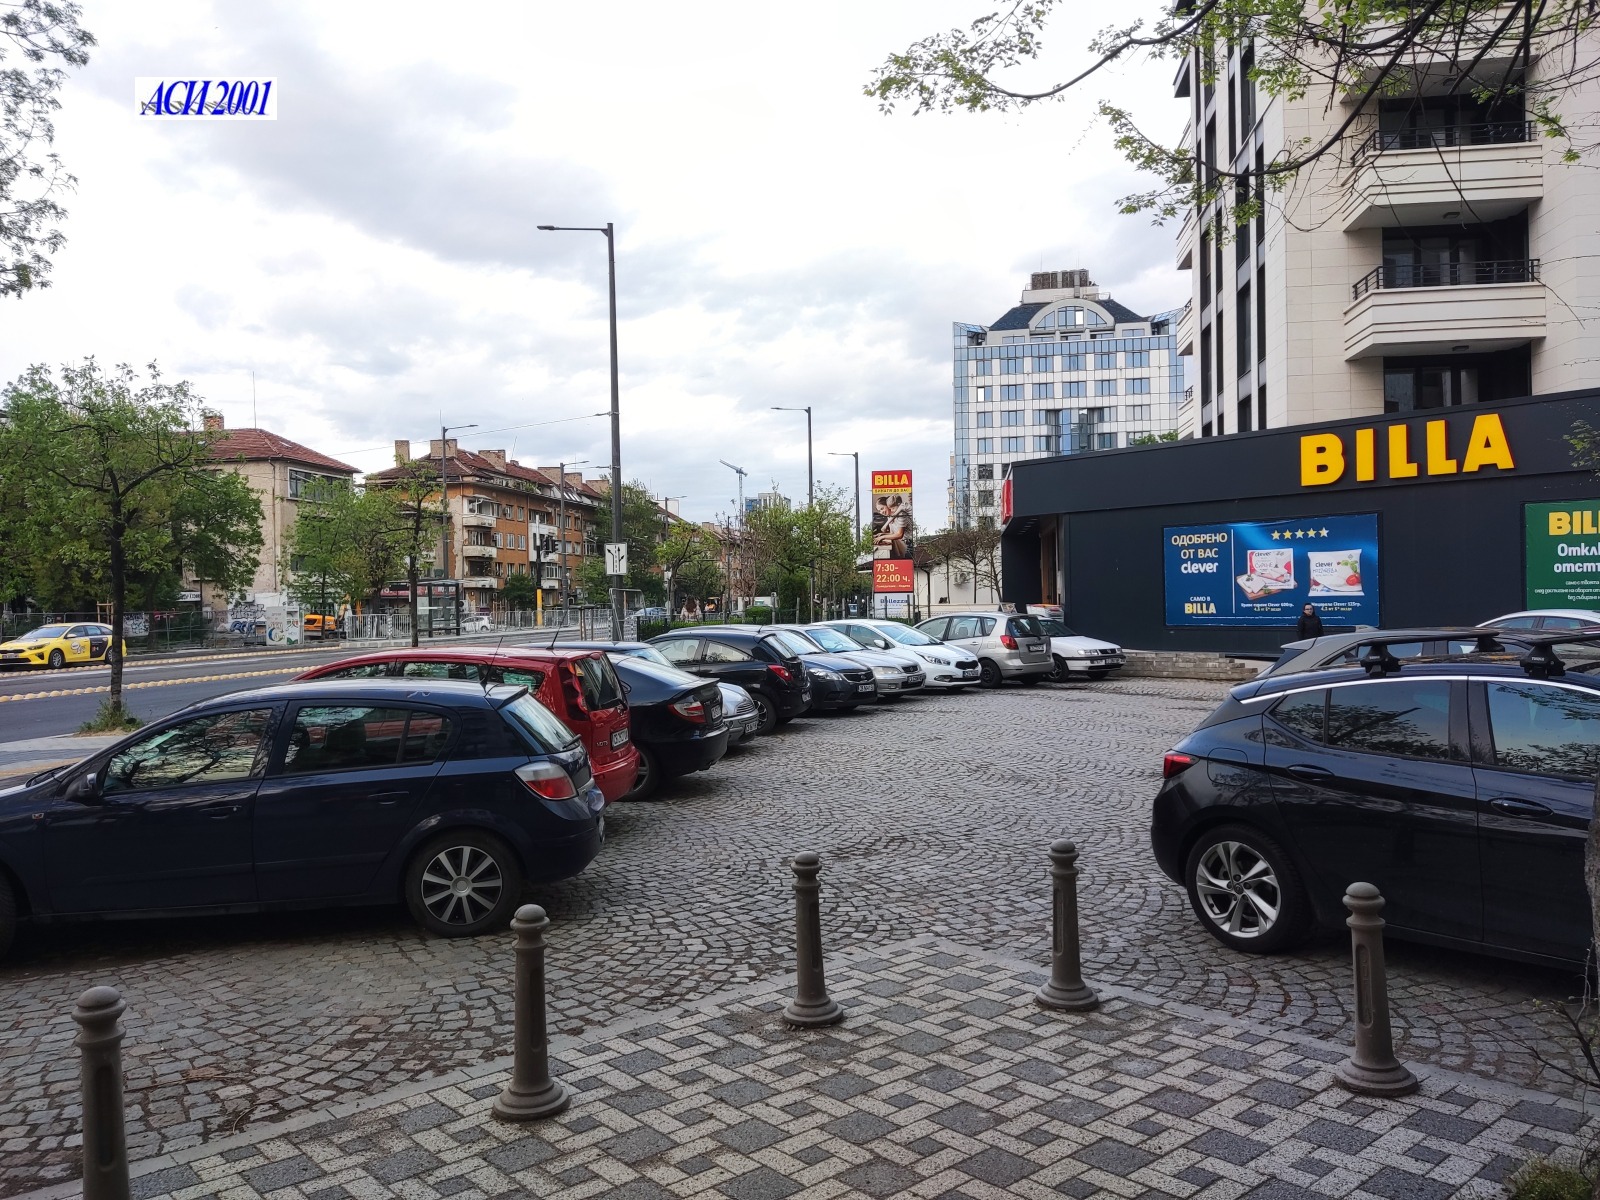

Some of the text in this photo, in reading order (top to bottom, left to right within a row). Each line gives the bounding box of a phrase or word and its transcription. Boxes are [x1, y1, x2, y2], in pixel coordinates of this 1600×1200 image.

[1301, 413, 1515, 487] BILLA
[874, 474, 909, 486] BILLA
[1548, 510, 1600, 536] BIL
[1171, 532, 1228, 547] ОДОБРЕНО
[1180, 548, 1219, 559] ОТ ВАС
[876, 563, 899, 572] 7:30-
[1180, 560, 1219, 574] clever
[876, 573, 901, 583] 22:00
[1184, 602, 1217, 614] BILLA
